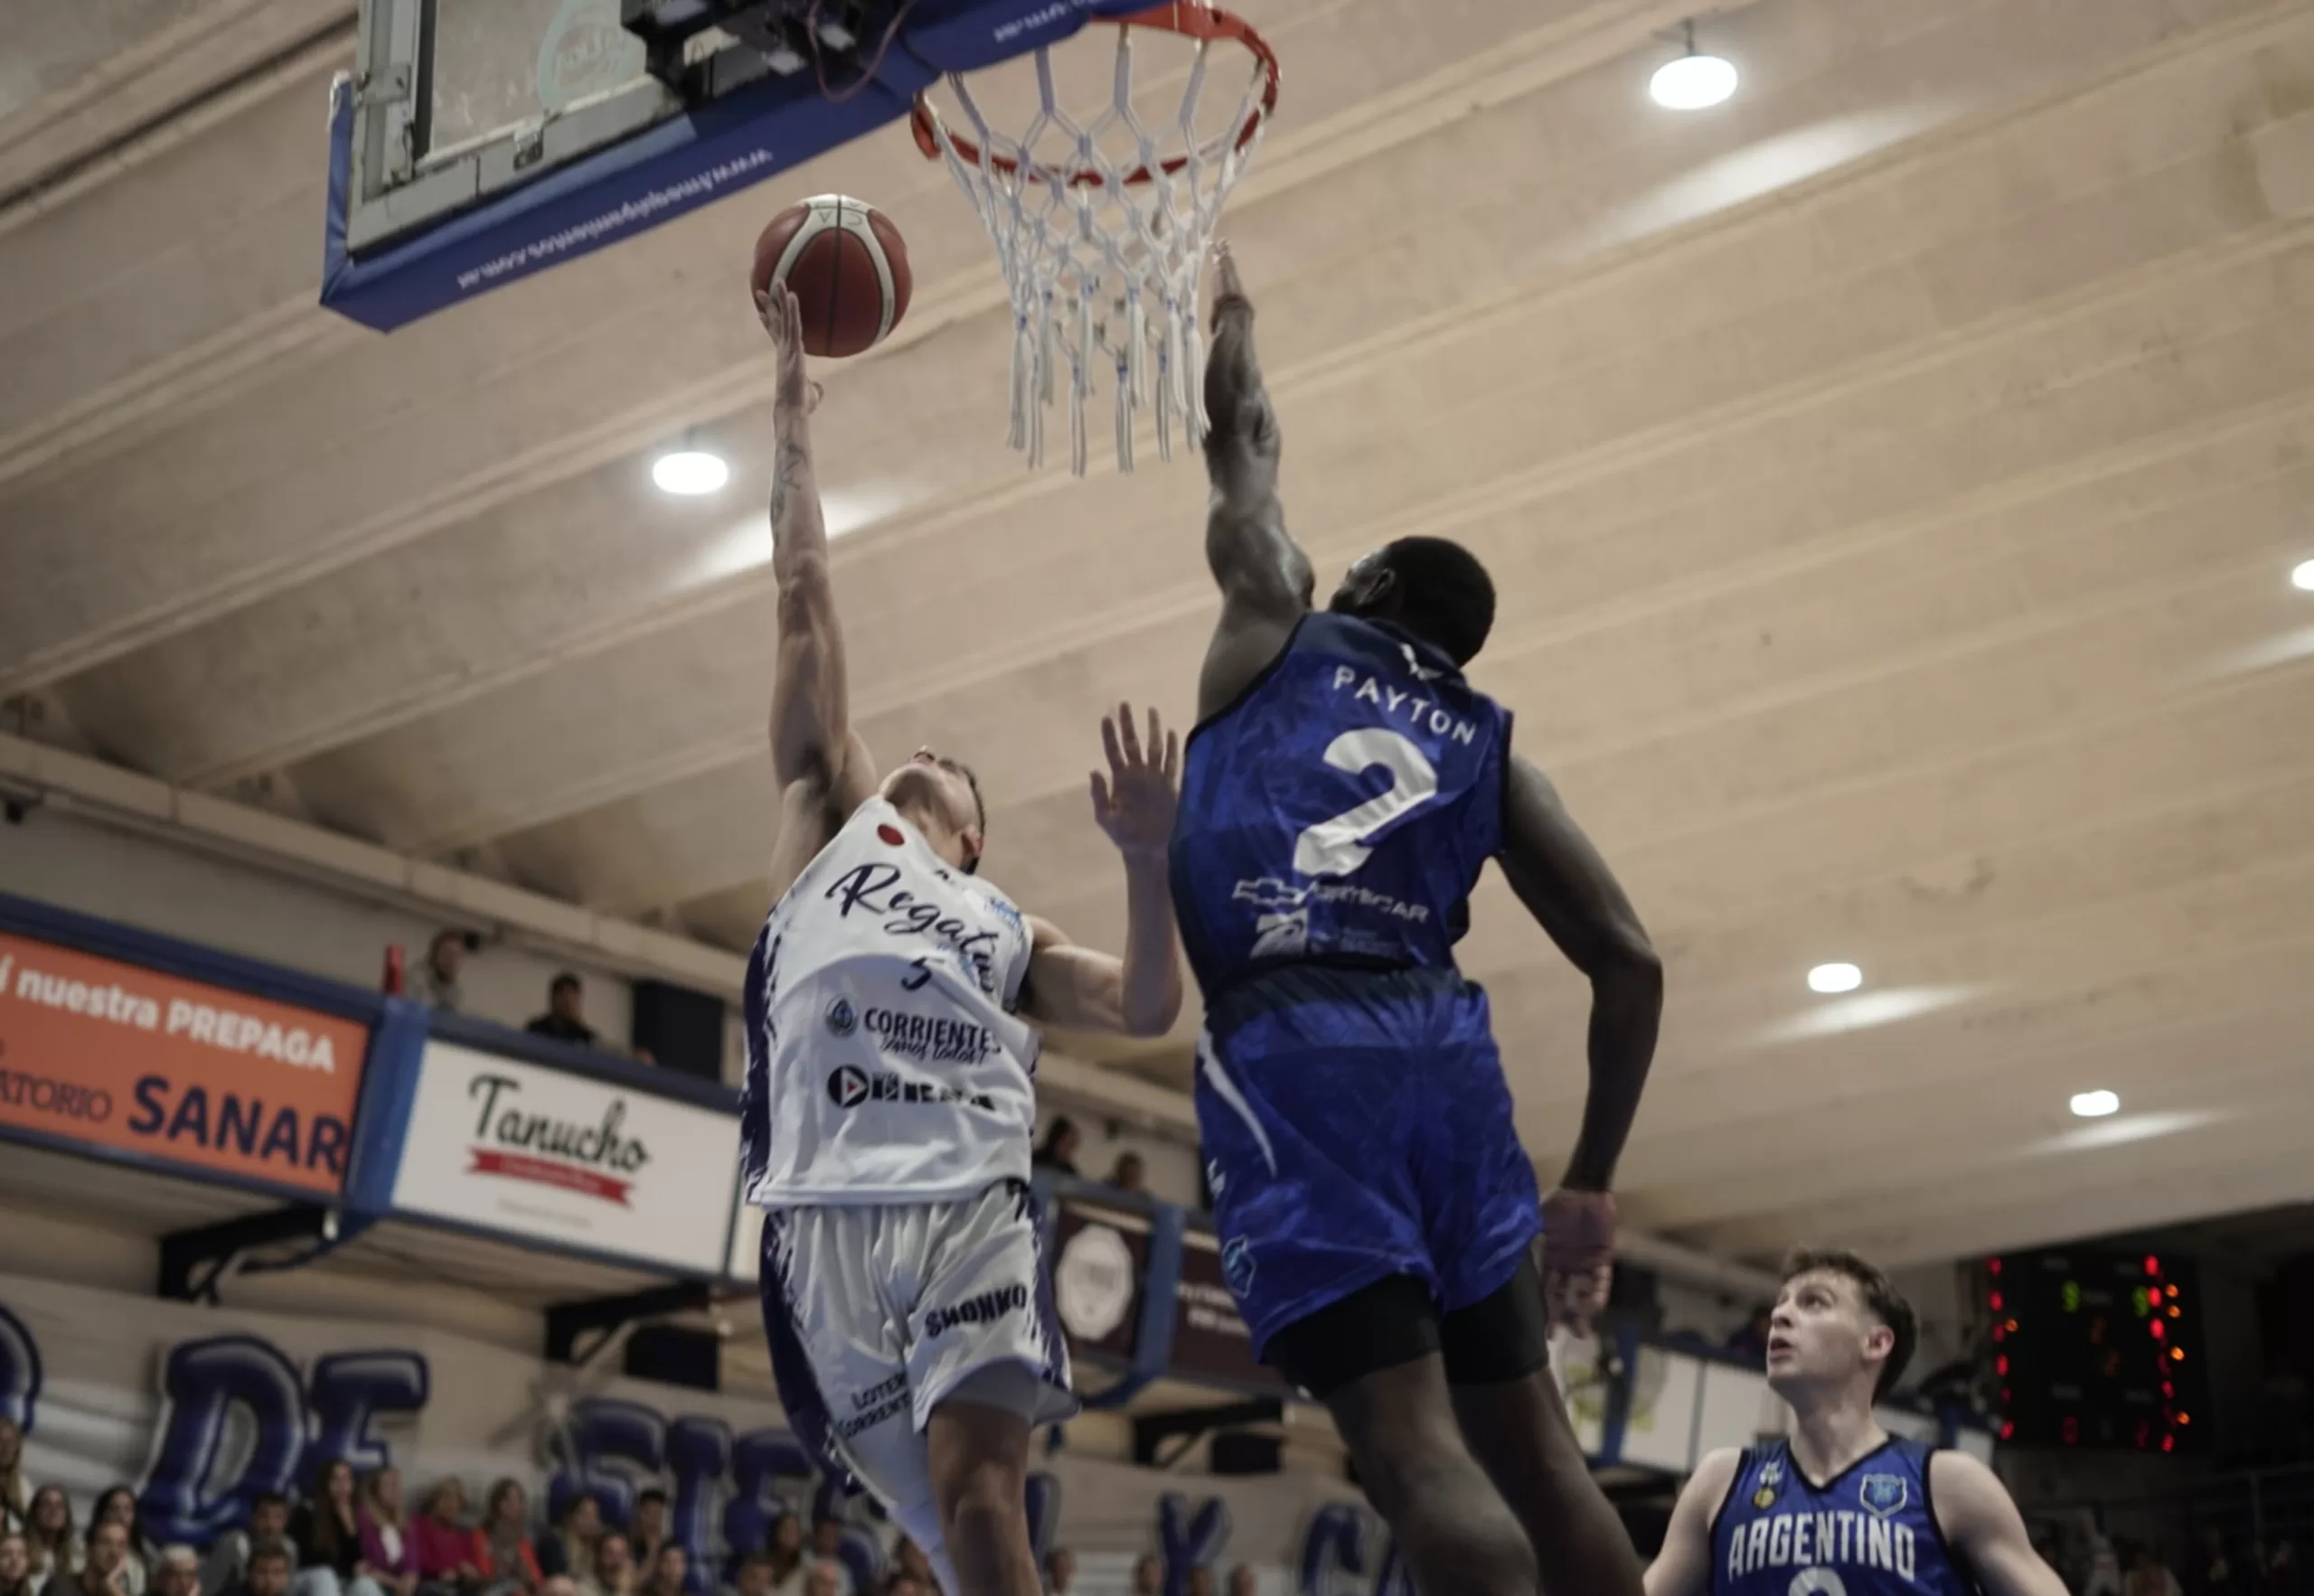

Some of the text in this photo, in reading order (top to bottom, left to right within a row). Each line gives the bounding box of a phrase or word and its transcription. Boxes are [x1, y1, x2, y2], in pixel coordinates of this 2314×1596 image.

[1331, 664, 1477, 746] PAYTON
[1293, 727, 1438, 878] 2
[16, 965, 159, 1031] nuestra
[165, 998, 336, 1074] PREPAGA
[128, 1074, 349, 1174] SANAR
[467, 1072, 652, 1173] Tanucho
[1727, 1509, 1916, 1583] ARGENTINO
